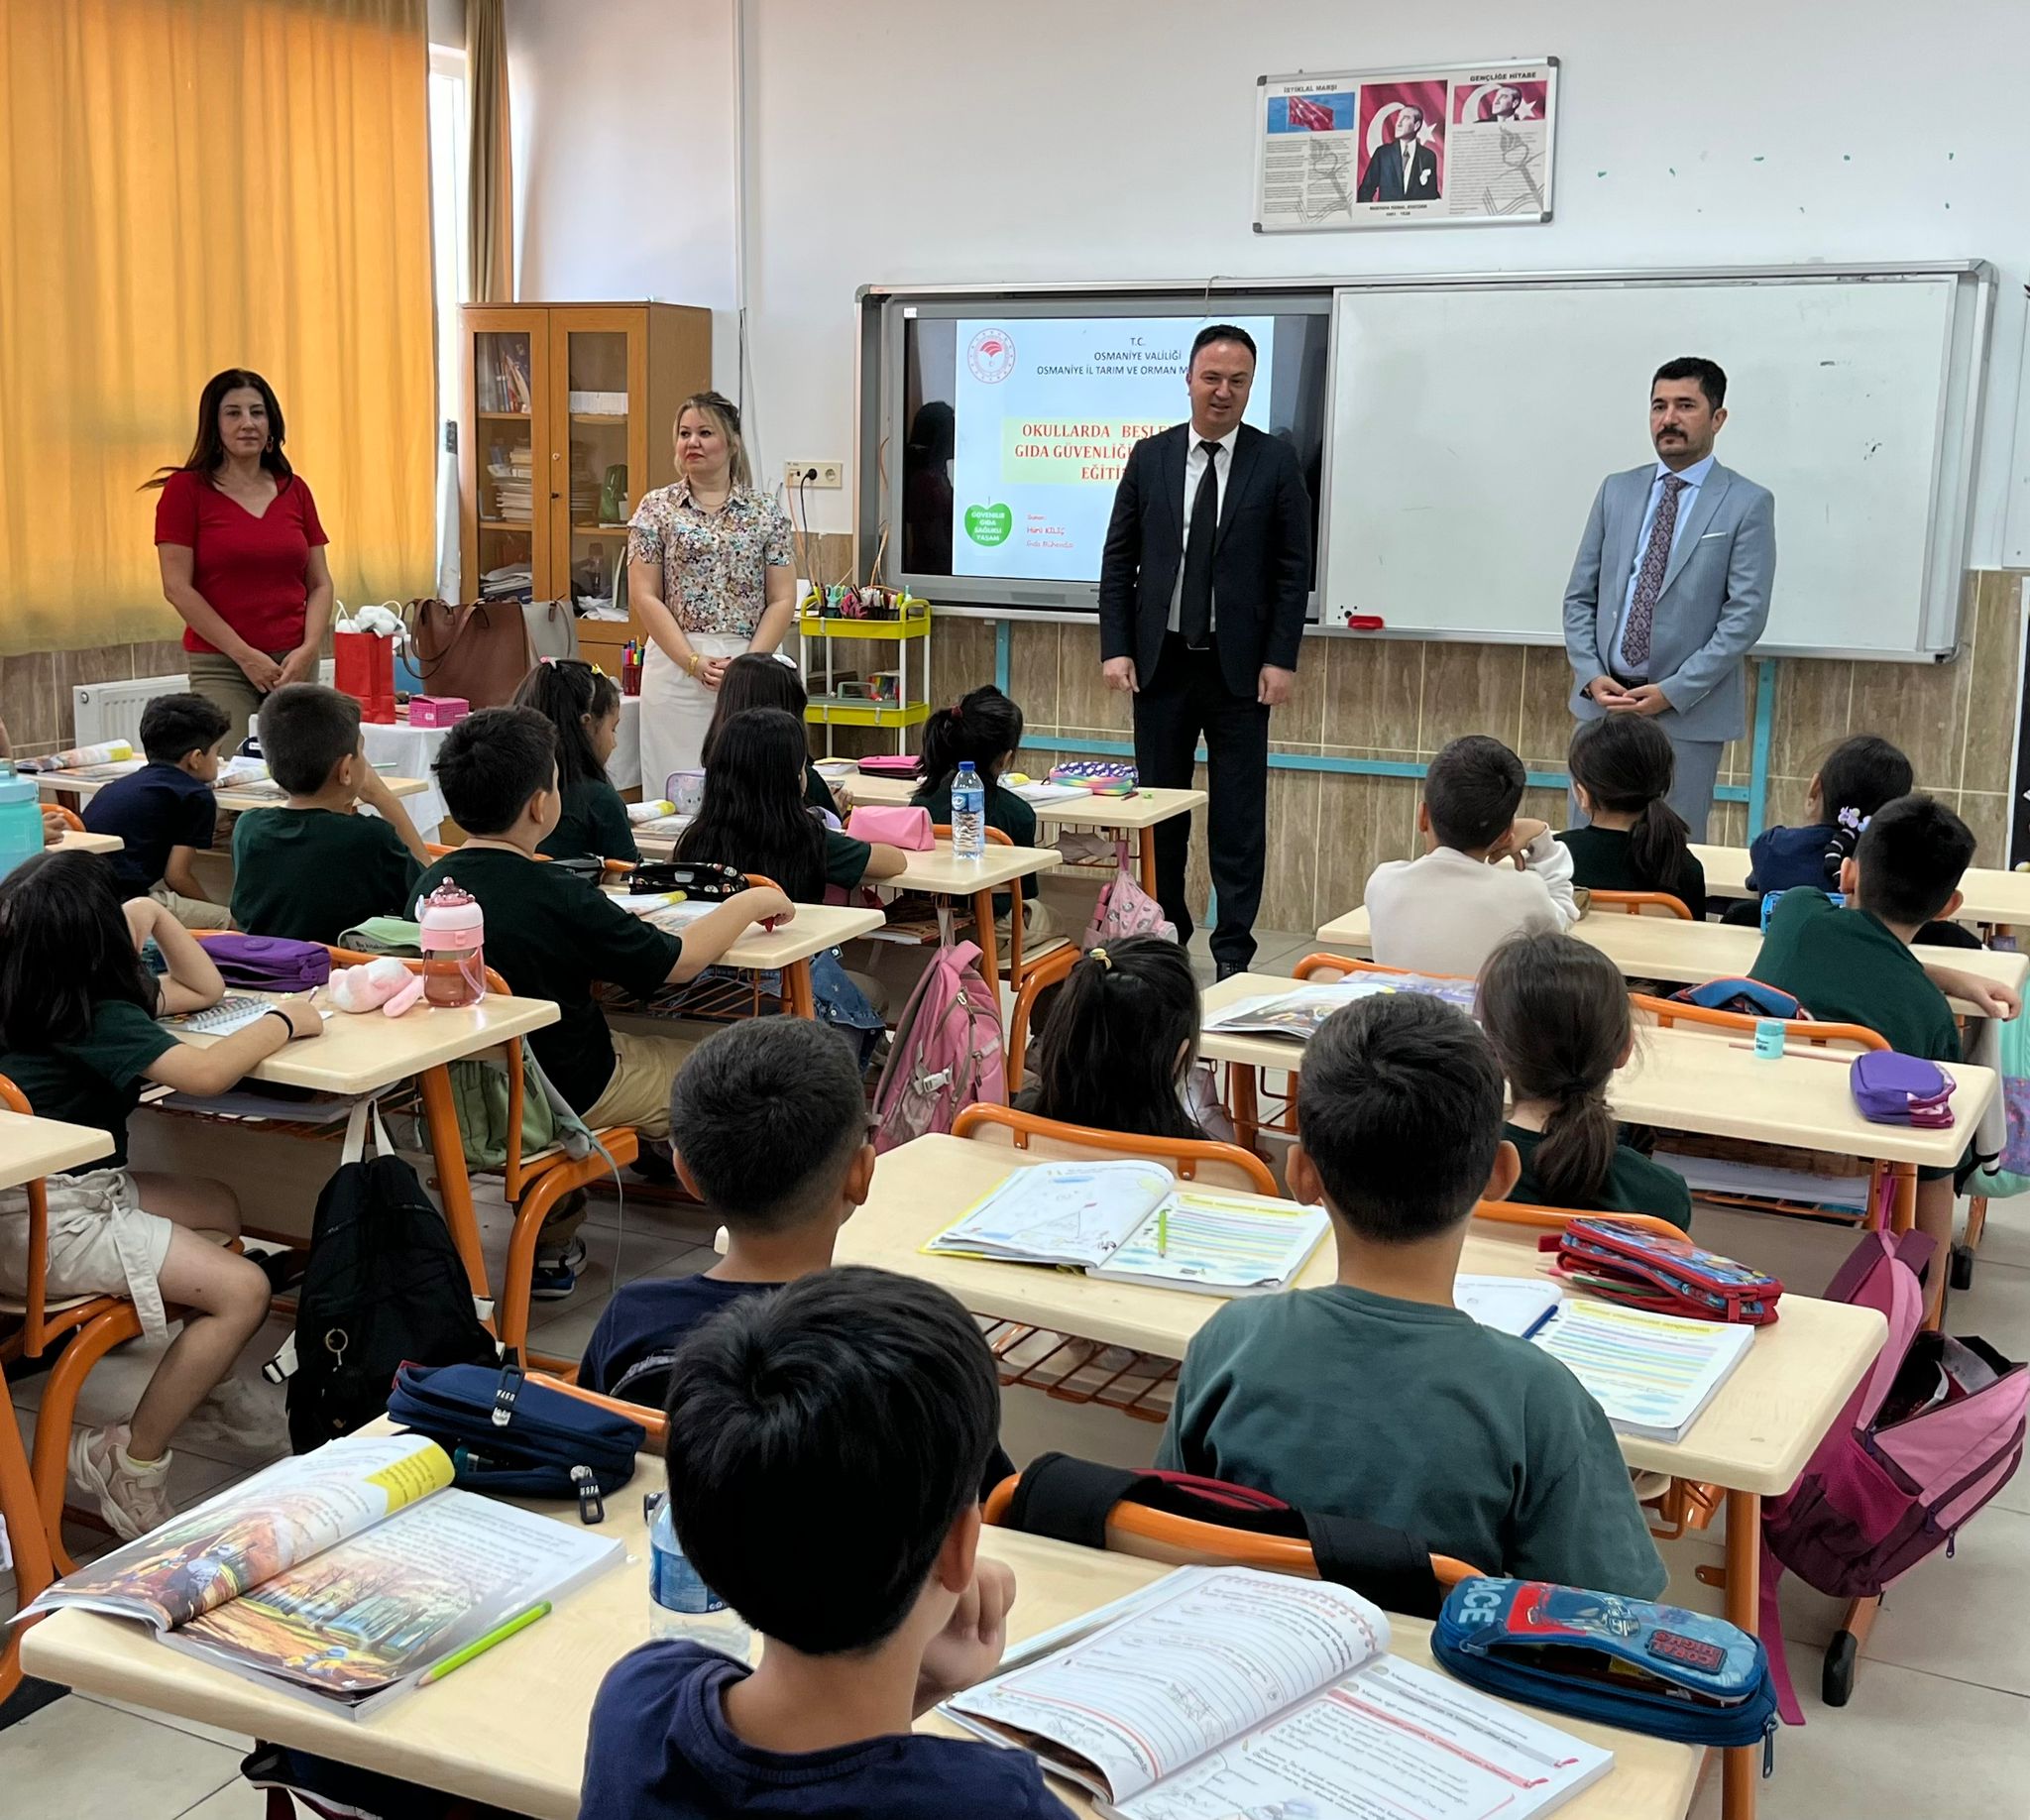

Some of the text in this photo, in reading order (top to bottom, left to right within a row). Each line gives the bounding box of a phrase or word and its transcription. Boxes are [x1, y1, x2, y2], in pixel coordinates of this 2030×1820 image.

[1130, 337, 1146, 347] T.C.
[1093, 349, 1182, 361] OSMANİYE VALİLİĞİ
[1037, 364, 1083, 375] OSMANİYE
[1085, 365, 1093, 375] İL
[1095, 365, 1124, 375] TARIM
[1126, 366, 1138, 375] VE
[1141, 366, 1176, 375] ORMAN
[1022, 424, 1110, 437] OKULLARDA
[1015, 444, 1049, 457] GIDA
[1081, 464, 1126, 480] EĞİTİ
